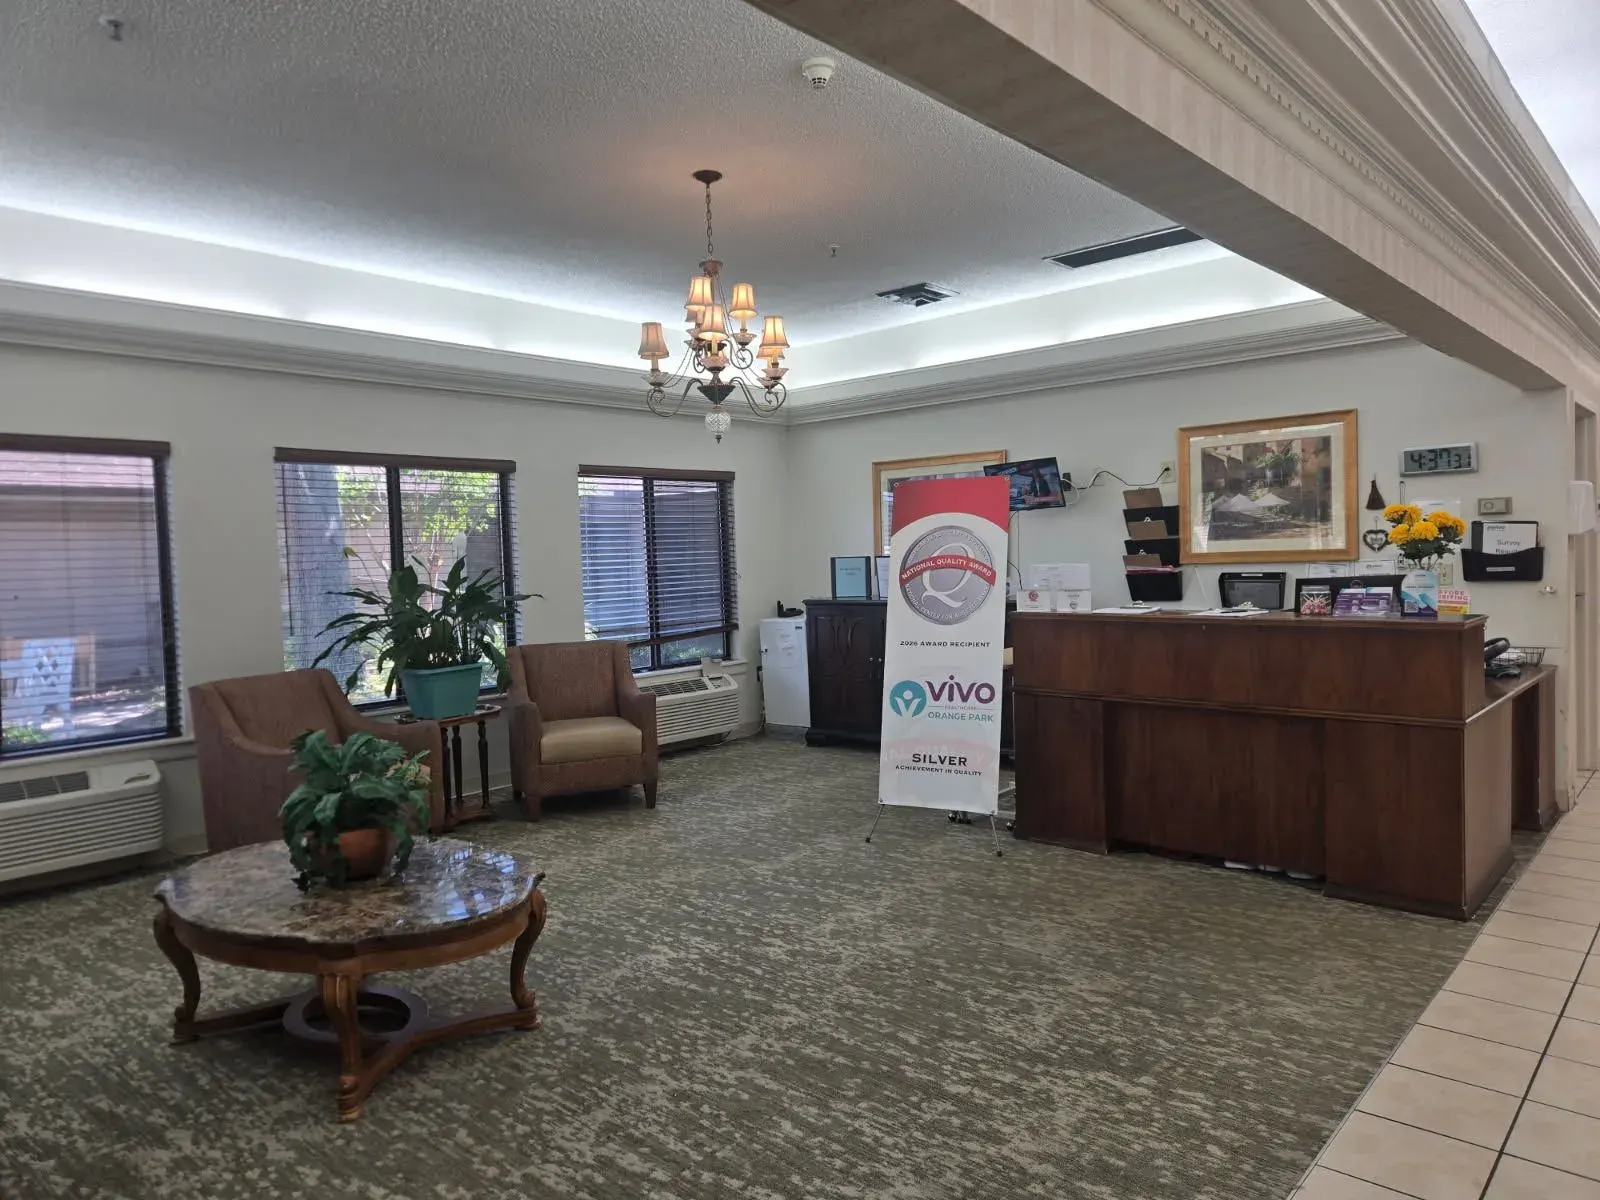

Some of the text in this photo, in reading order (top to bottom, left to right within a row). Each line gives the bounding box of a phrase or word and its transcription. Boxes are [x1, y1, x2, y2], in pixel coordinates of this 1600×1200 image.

[902, 558, 992, 580] NATIONAL QUALITY AWARD
[927, 711, 994, 722] ORANGE PARK
[912, 753, 968, 767] SILVER
[895, 765, 944, 774] ACHIEVEMENT
